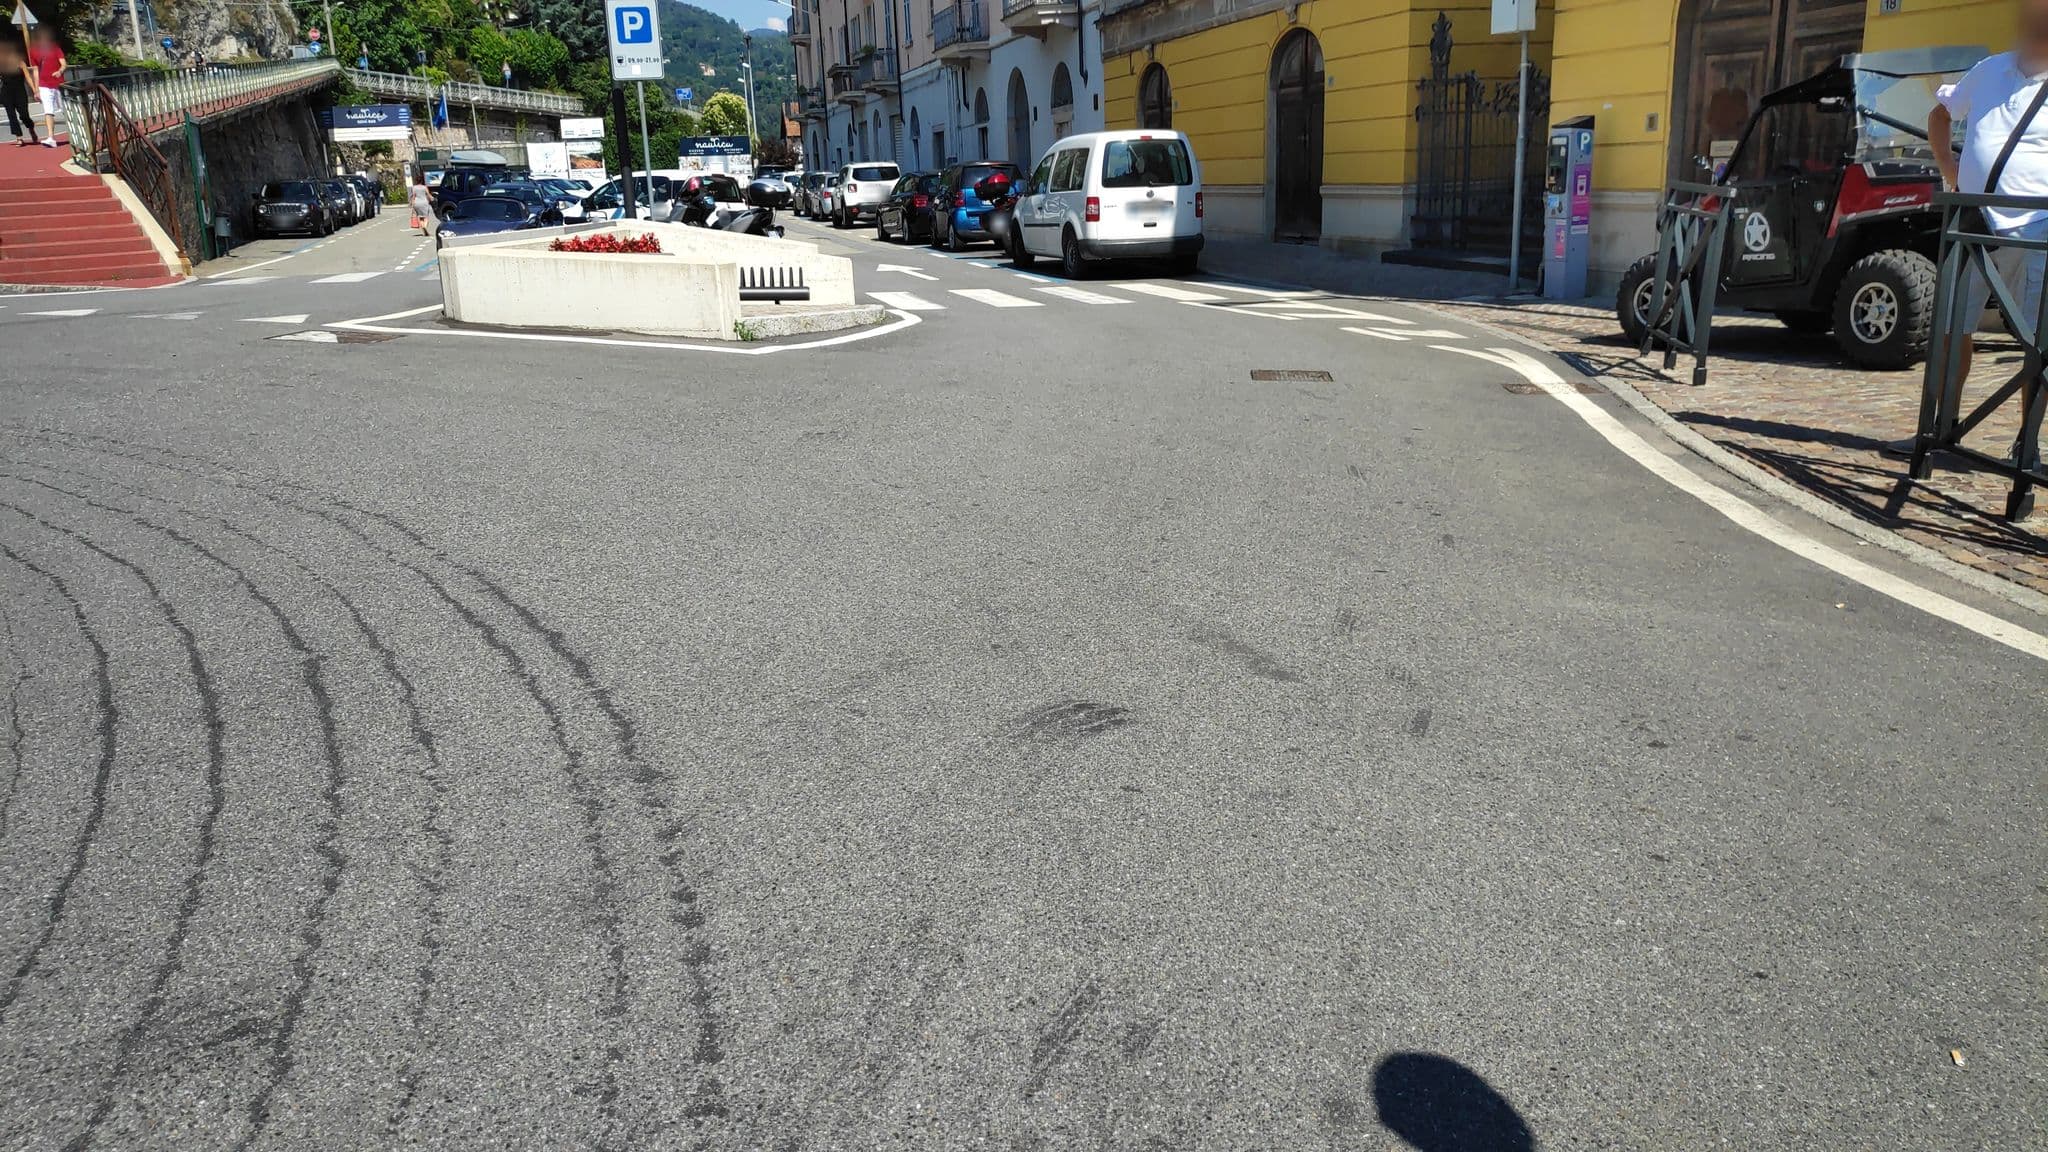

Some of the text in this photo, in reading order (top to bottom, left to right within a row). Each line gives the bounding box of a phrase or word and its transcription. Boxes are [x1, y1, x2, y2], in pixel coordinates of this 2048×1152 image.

[1885, 0, 1897, 10] 18
[622, 11, 644, 40] P
[695, 137, 734, 149] nautica
[1580, 132, 1591, 151] P
